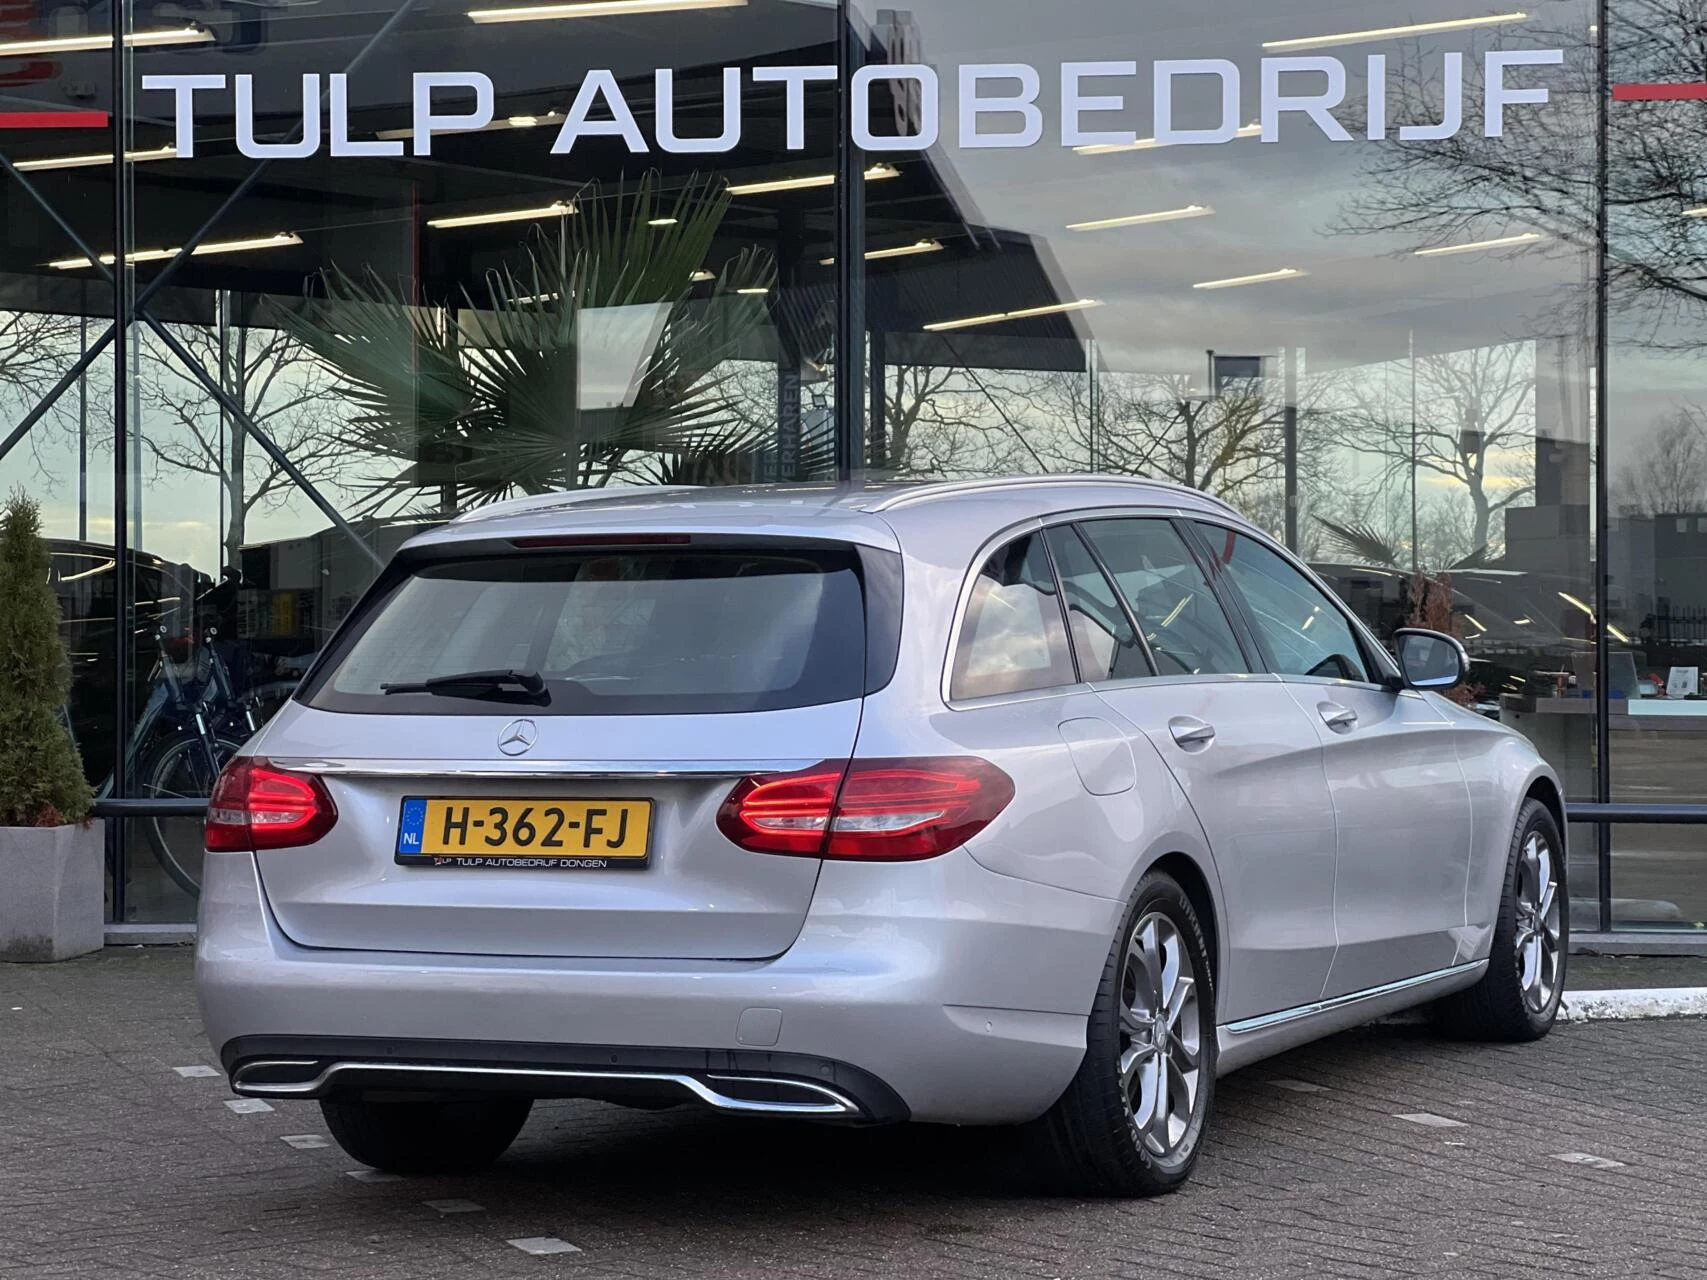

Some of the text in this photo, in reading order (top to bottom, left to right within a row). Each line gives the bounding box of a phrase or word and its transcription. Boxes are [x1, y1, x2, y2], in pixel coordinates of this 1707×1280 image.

[141, 71, 494, 159] TULP
[551, 48, 1564, 154] AUTOBEDRIJF
[403, 832, 419, 845] NL
[442, 806, 629, 849] H-362-FJ
[456, 857, 483, 866] TULP
[485, 858, 557, 867] AUTOBEDRIJF
[560, 859, 607, 868] DONGEN
